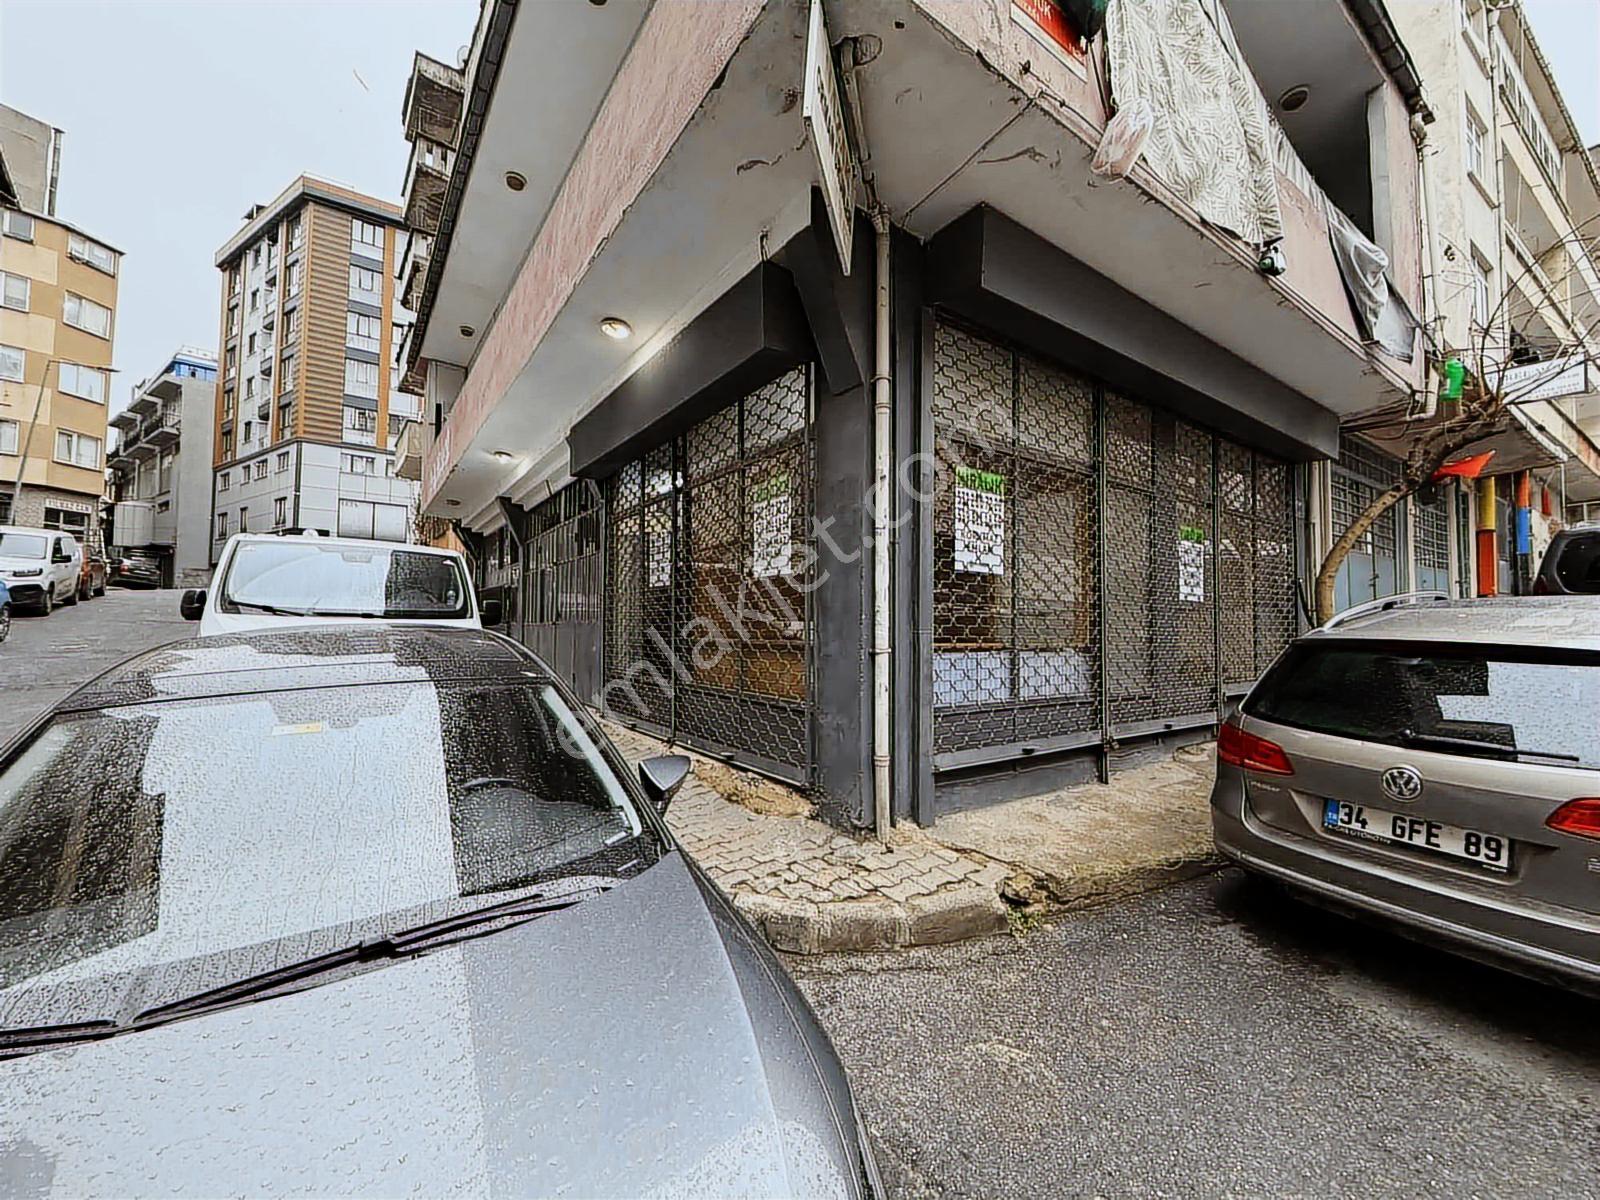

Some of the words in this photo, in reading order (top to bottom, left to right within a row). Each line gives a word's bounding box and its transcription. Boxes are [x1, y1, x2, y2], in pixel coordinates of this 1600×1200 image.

[1339, 802, 1368, 829] 34
[1391, 814, 1443, 848] GFE
[1463, 831, 1503, 863] 89
